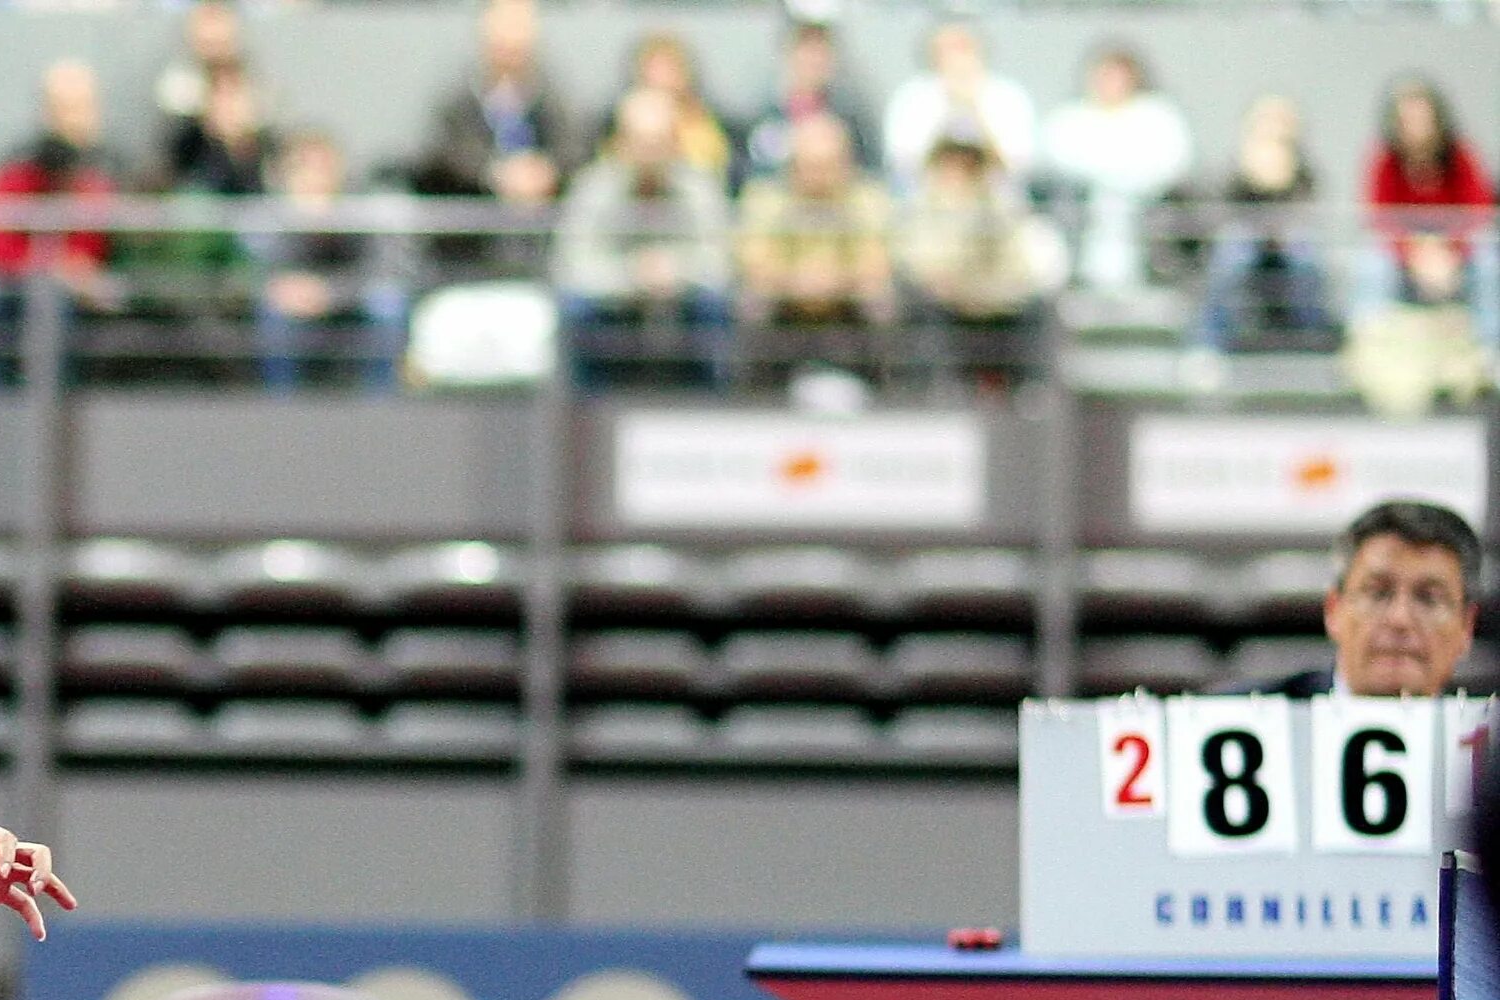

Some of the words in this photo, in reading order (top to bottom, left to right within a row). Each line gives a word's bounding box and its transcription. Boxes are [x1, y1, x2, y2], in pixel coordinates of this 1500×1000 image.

[1113, 733, 1154, 806] 2
[1201, 730, 1271, 838] 8
[1342, 729, 1409, 837] 6
